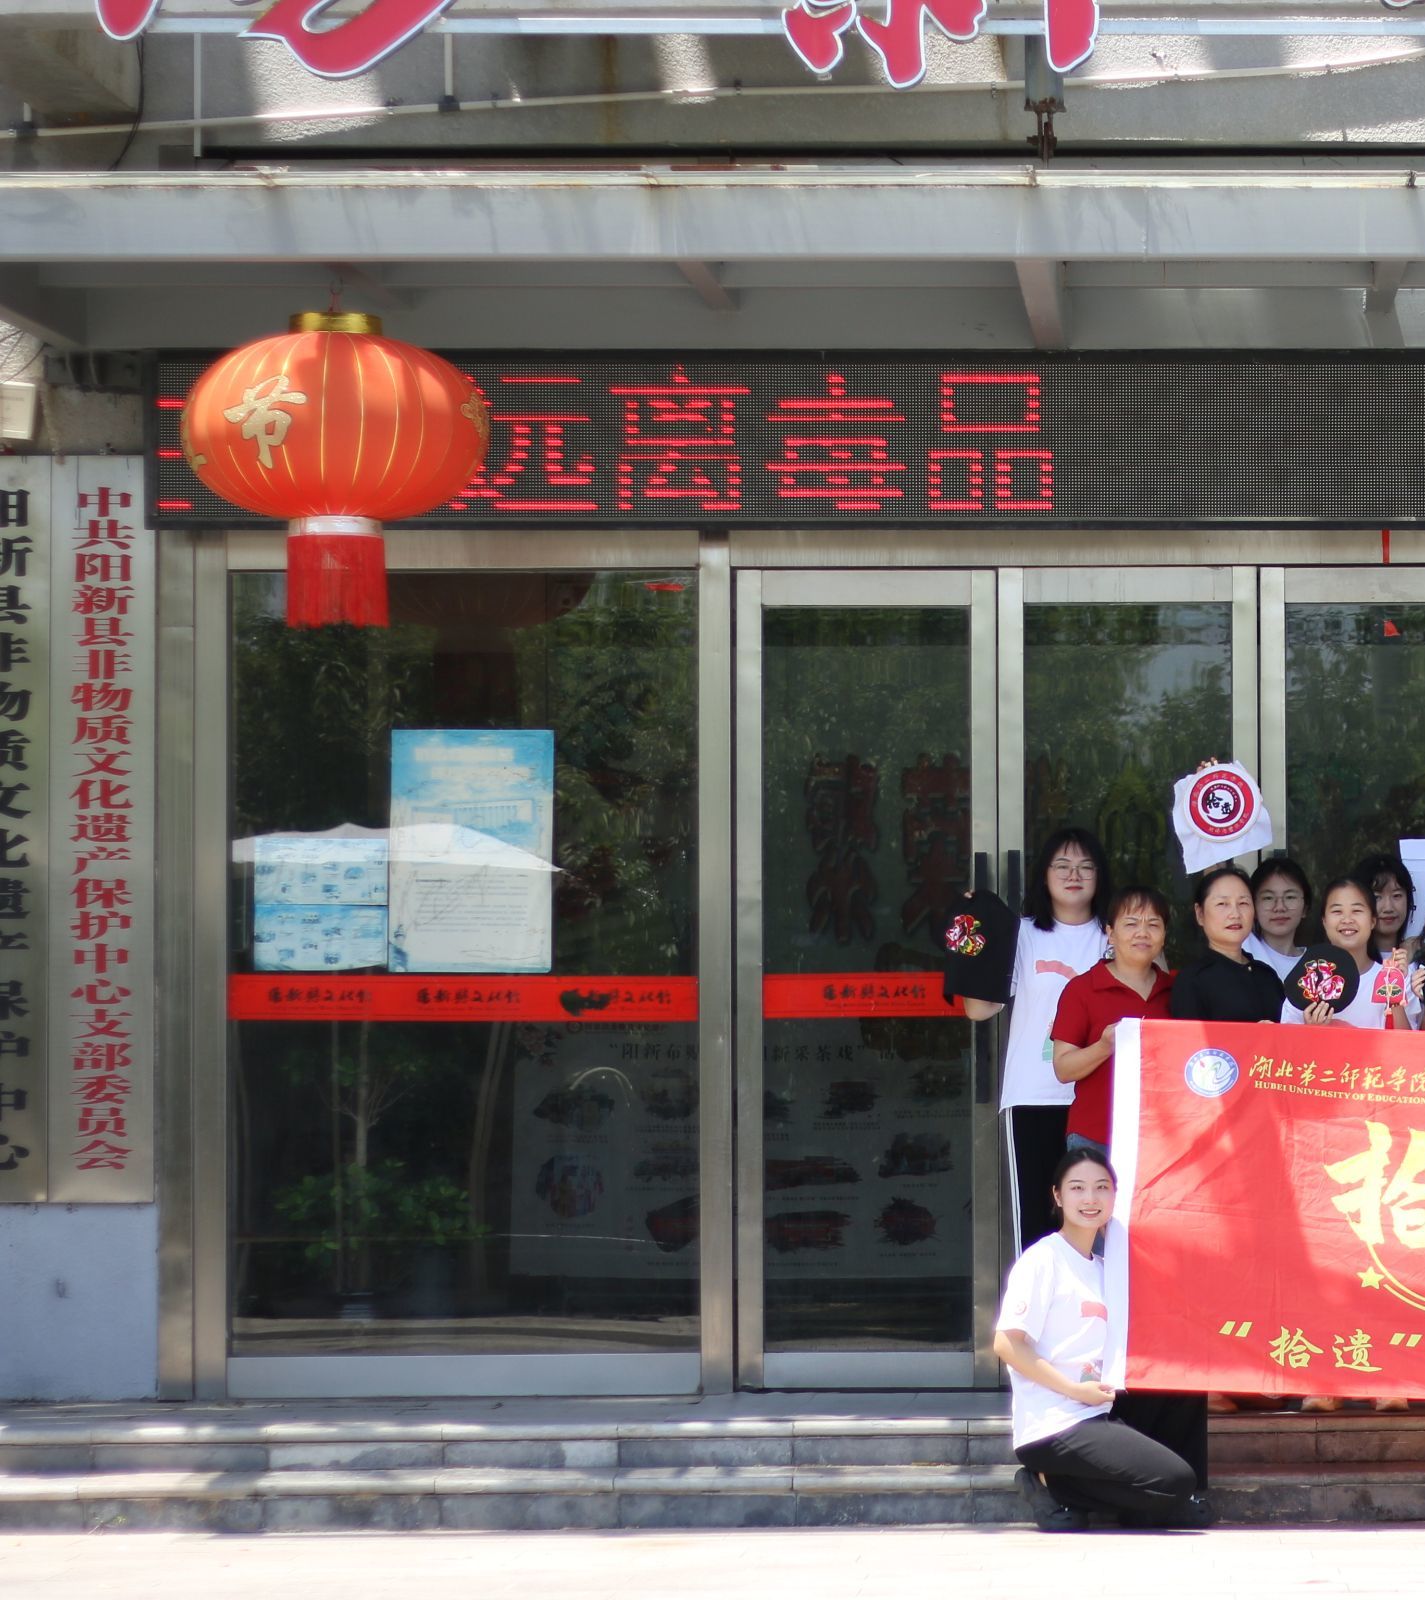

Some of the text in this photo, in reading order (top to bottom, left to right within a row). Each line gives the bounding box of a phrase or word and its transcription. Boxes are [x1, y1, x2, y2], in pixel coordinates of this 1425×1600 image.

[223, 374, 308, 469] 节
[70, 486, 136, 1172] 中共阳新县非物质文化遗产保护中心支部委员会
[1254, 1080, 1287, 1092] HUBEI
[1289, 1085, 1351, 1100] UNIVERSITY
[1352, 1091, 1365, 1101] OF
